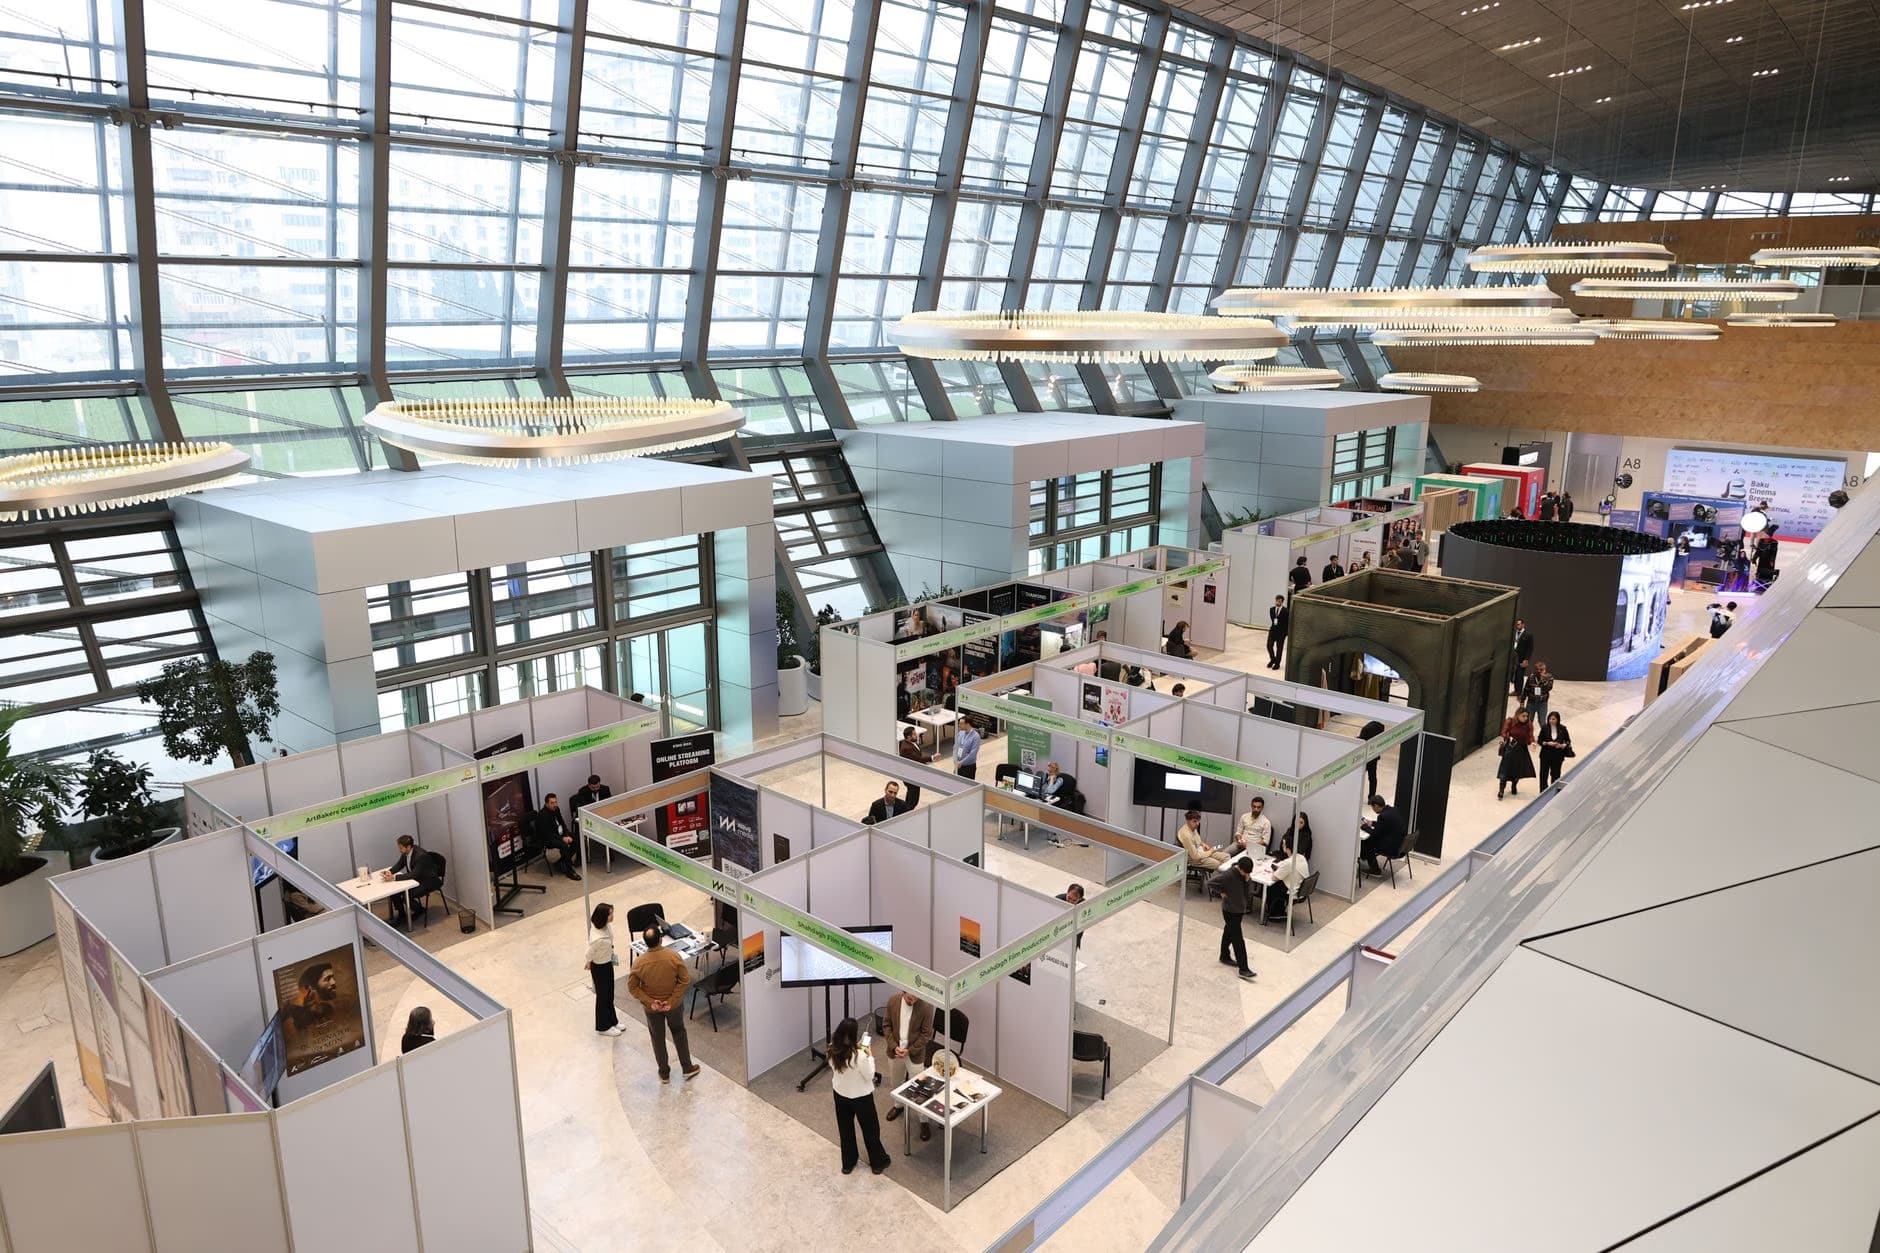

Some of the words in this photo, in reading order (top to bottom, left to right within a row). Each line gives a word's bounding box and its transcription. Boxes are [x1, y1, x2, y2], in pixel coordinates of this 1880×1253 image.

[1623, 458, 1641, 469] A8
[1749, 487, 1777, 496] Cinema
[1750, 480, 1770, 488] Baku
[1085, 728, 1107, 740] anima
[560, 740, 588, 751] Streaming
[588, 734, 610, 744] Platform
[656, 754, 677, 764] ONLINE
[677, 749, 710, 760] STREAMING
[669, 757, 699, 768] PLATFORM
[1194, 760, 1223, 771] Animation
[305, 809, 340, 823] ArtBakers
[341, 801, 368, 814] Creative
[369, 791, 406, 805] Advertising
[406, 784, 430, 795] Agency
[655, 853, 681, 868] Production
[1106, 895, 1123, 906] Chinar
[1123, 889, 1134, 897] Film
[1134, 875, 1160, 892] Production
[797, 920, 827, 939] Shahdagh
[827, 934, 840, 945] Film
[840, 941, 874, 961] Production
[979, 958, 1008, 978] Shahdagh
[1008, 951, 1021, 962] Film
[1021, 934, 1050, 954] Production
